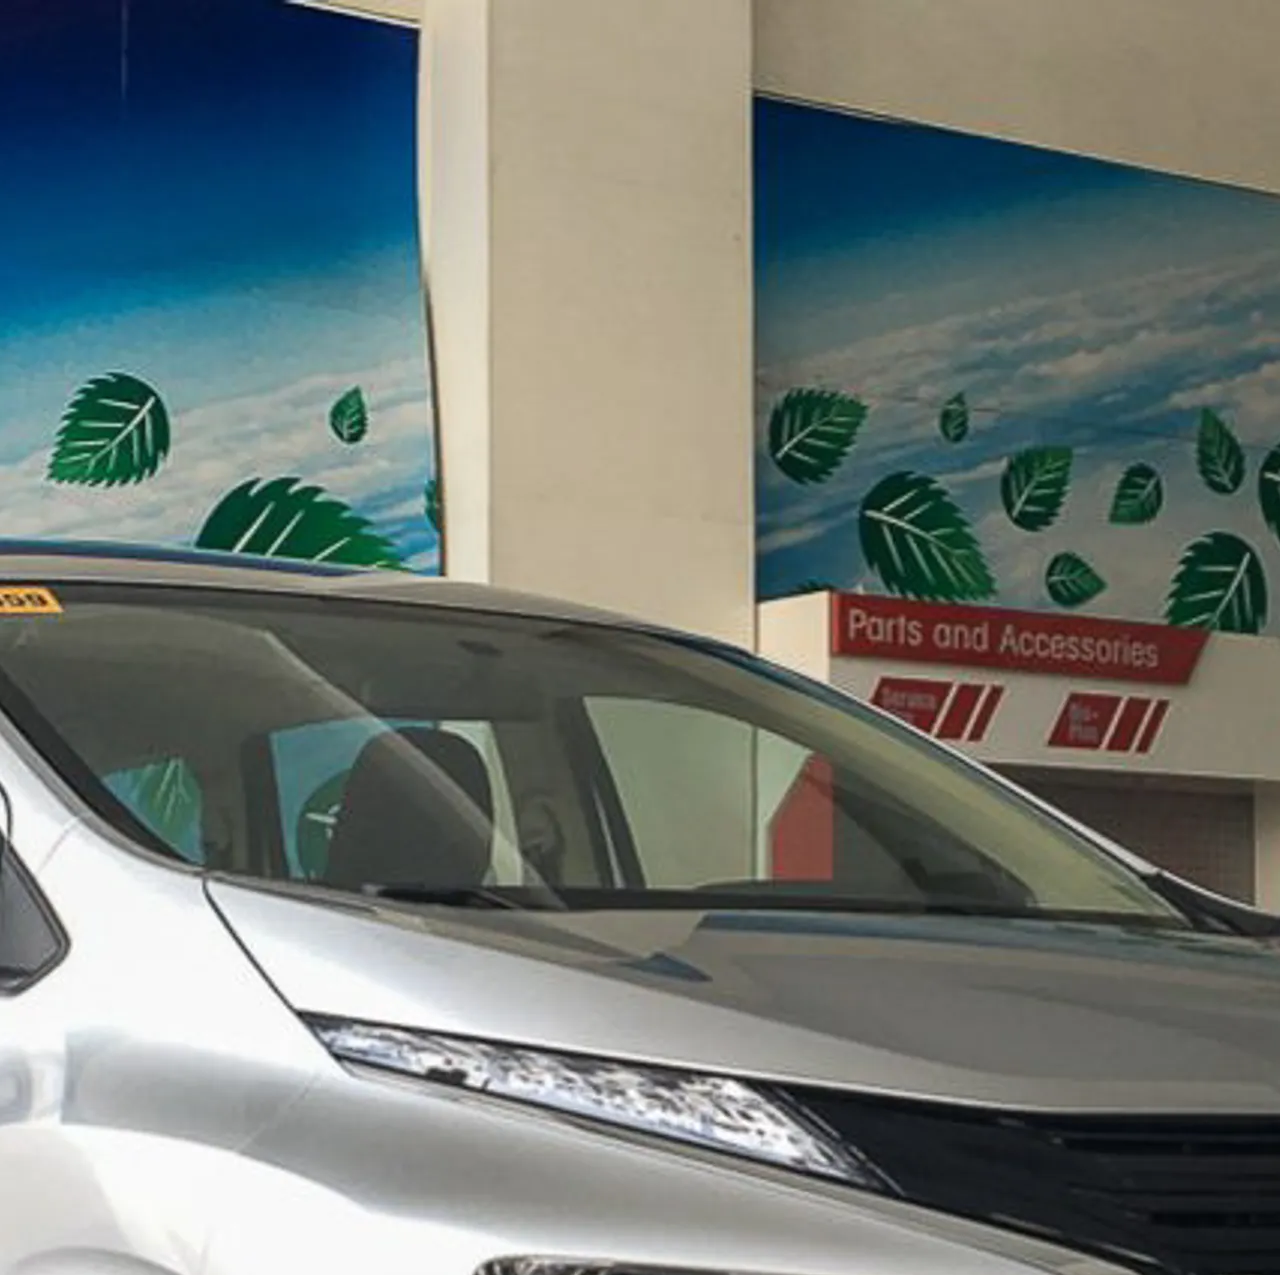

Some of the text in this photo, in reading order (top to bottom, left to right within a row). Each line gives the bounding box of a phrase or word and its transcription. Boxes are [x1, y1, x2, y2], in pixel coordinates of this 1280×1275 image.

[848, 608, 1159, 668] Parts and Accessories
